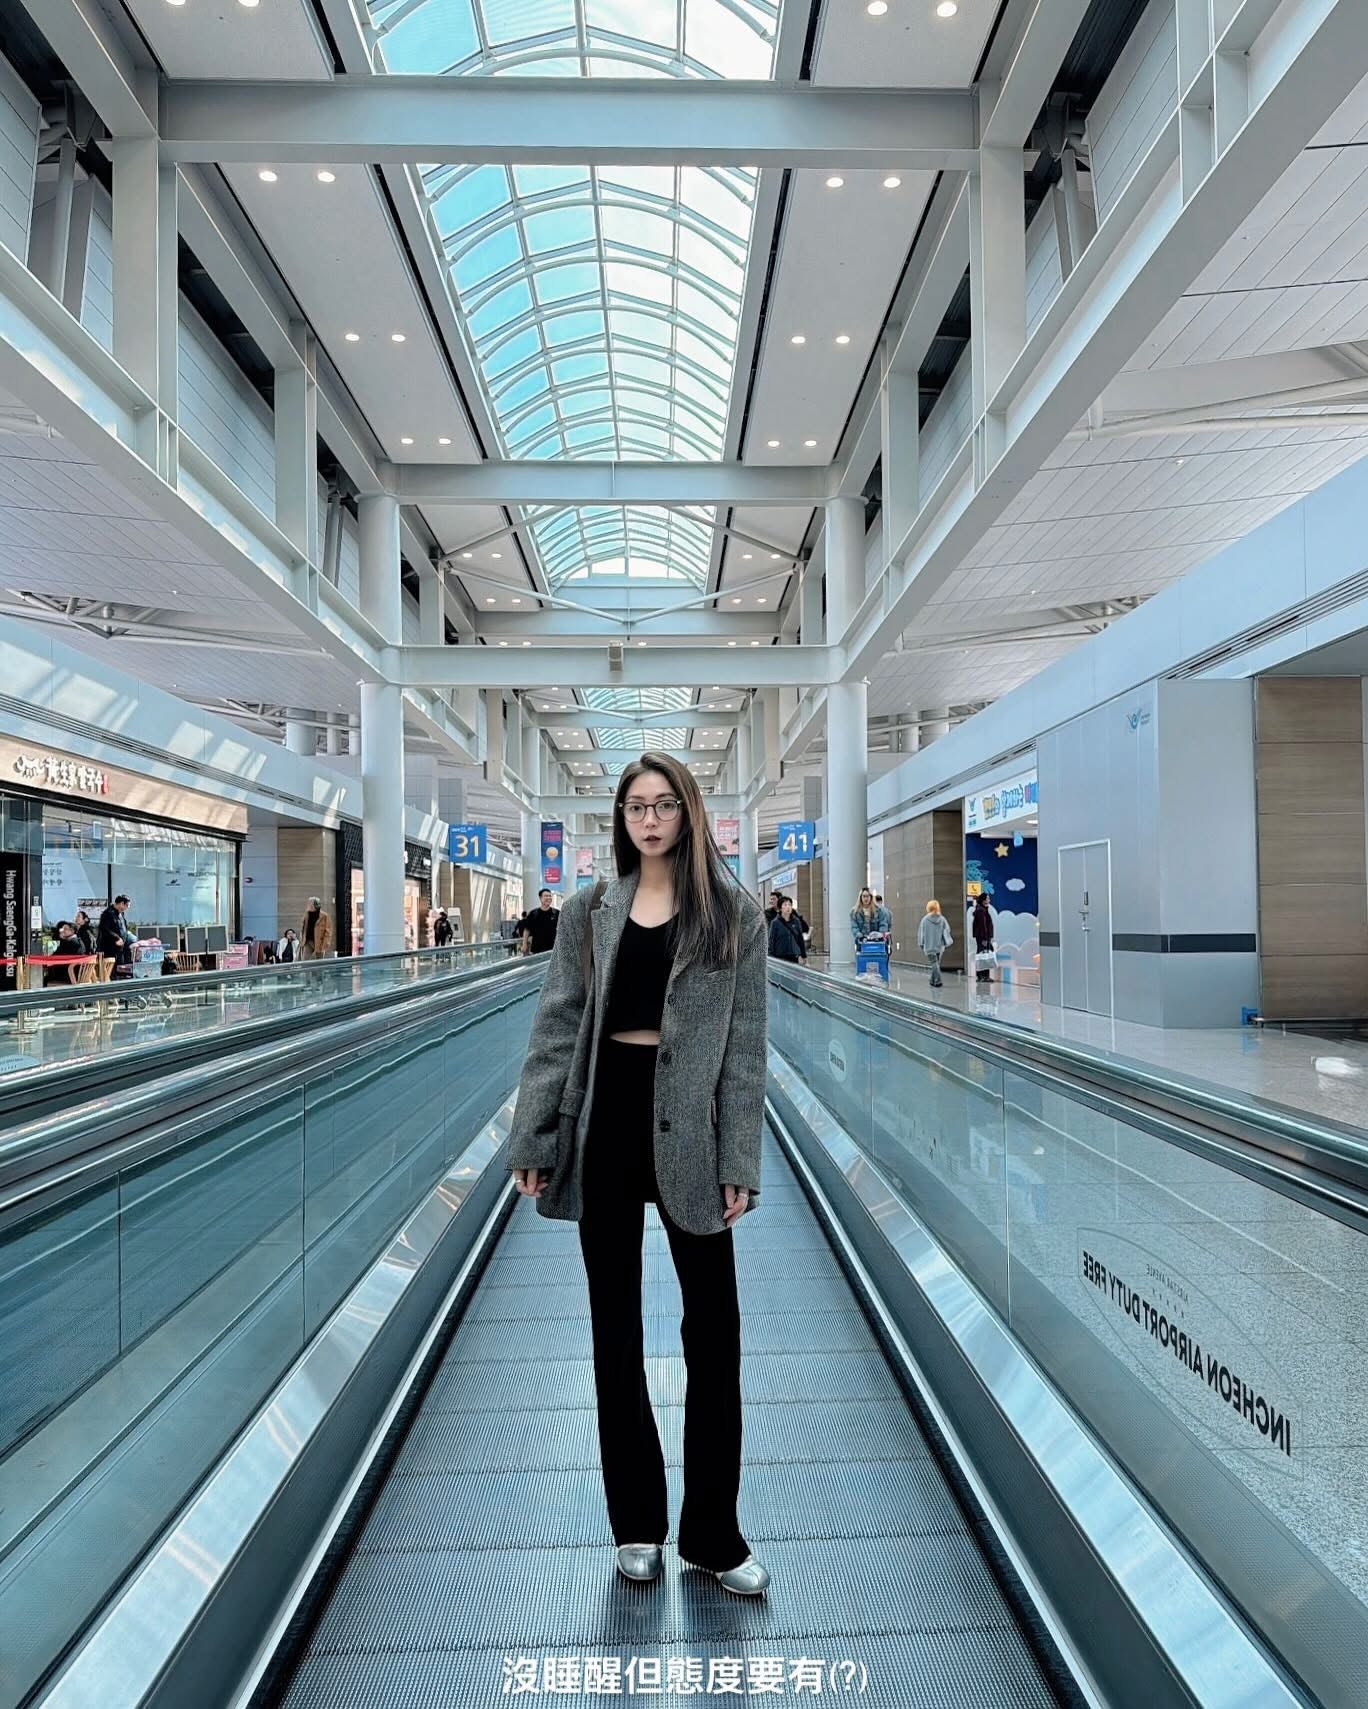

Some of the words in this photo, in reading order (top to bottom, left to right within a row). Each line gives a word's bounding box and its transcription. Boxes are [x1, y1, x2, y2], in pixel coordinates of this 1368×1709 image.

[454, 833, 479, 856] 31
[782, 832, 808, 853] 41
[3, 869, 17, 899] Hwang
